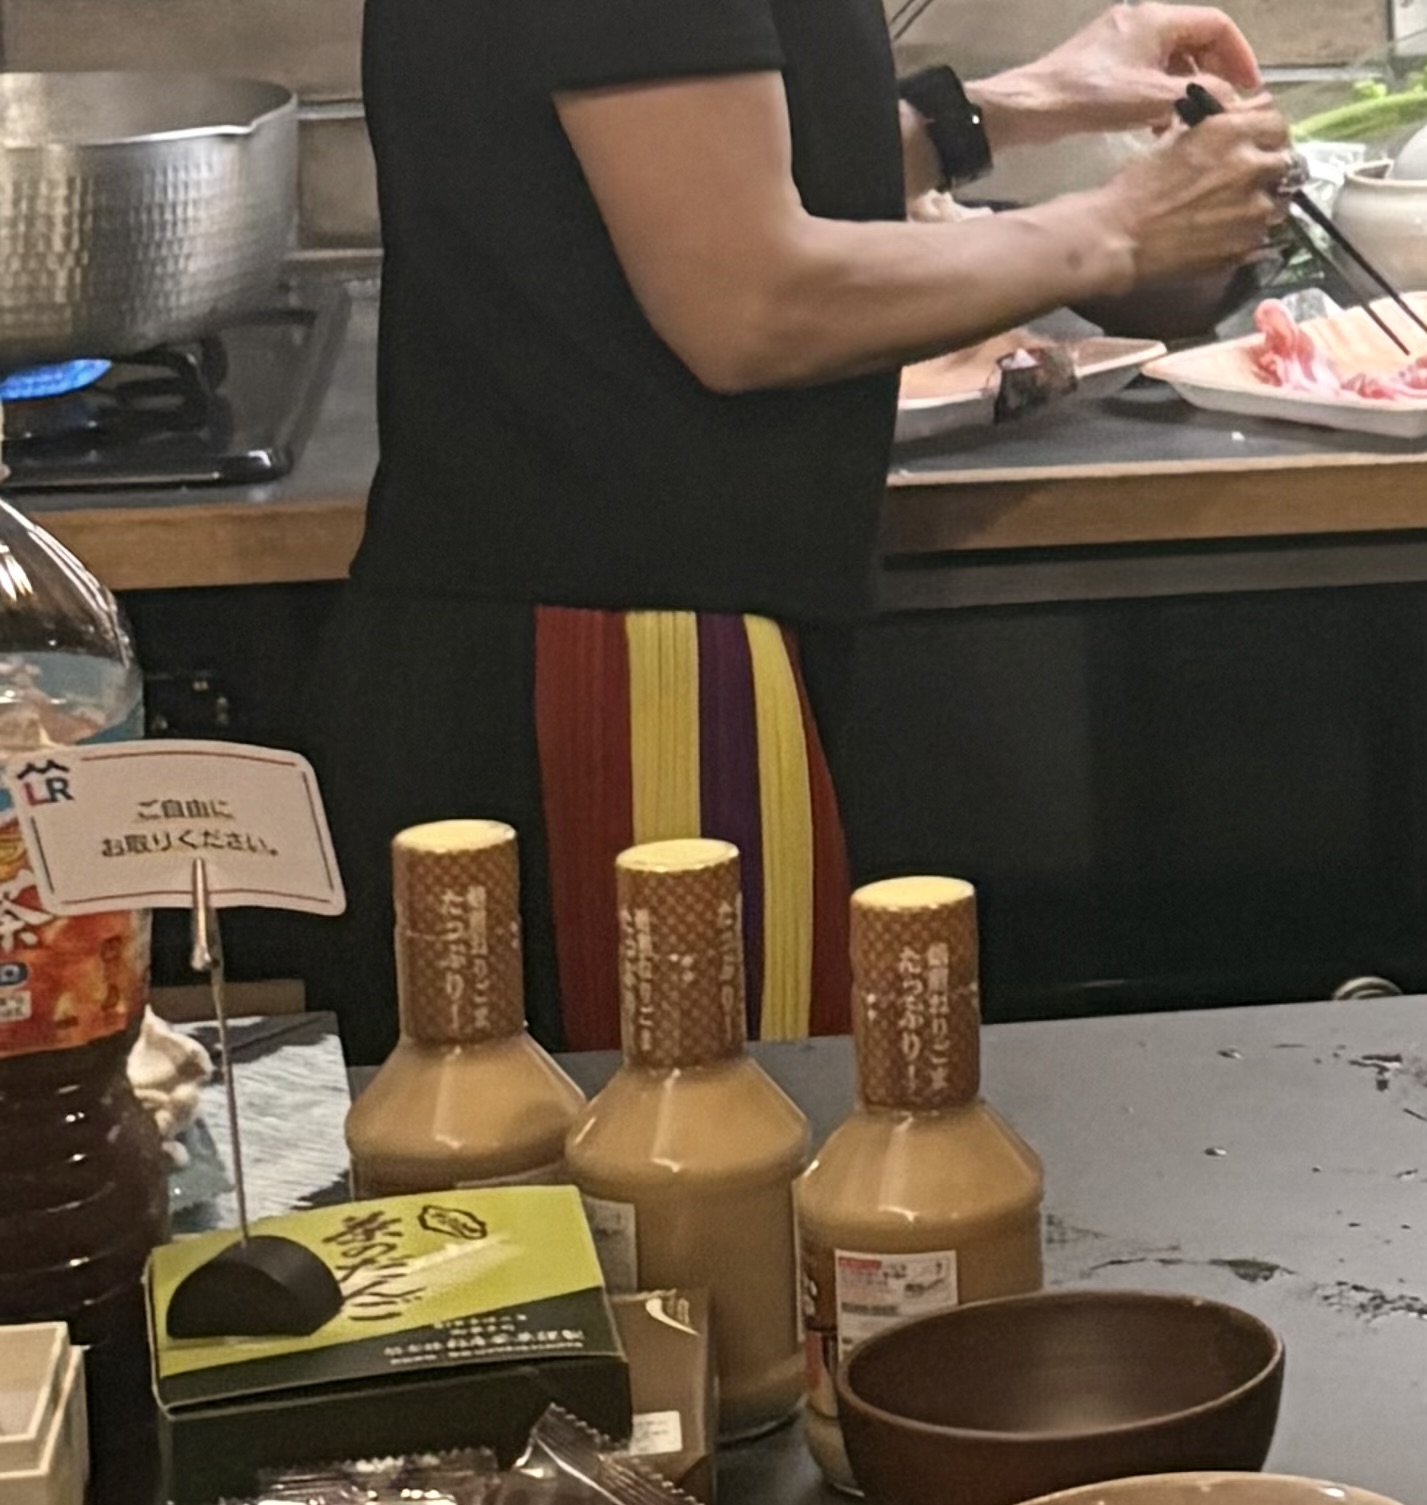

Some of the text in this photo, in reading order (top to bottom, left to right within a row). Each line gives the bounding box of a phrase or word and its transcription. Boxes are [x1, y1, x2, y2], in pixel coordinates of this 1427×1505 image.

[137, 798, 235, 821] ご自由に
[101, 828, 278, 857] お取りください。
